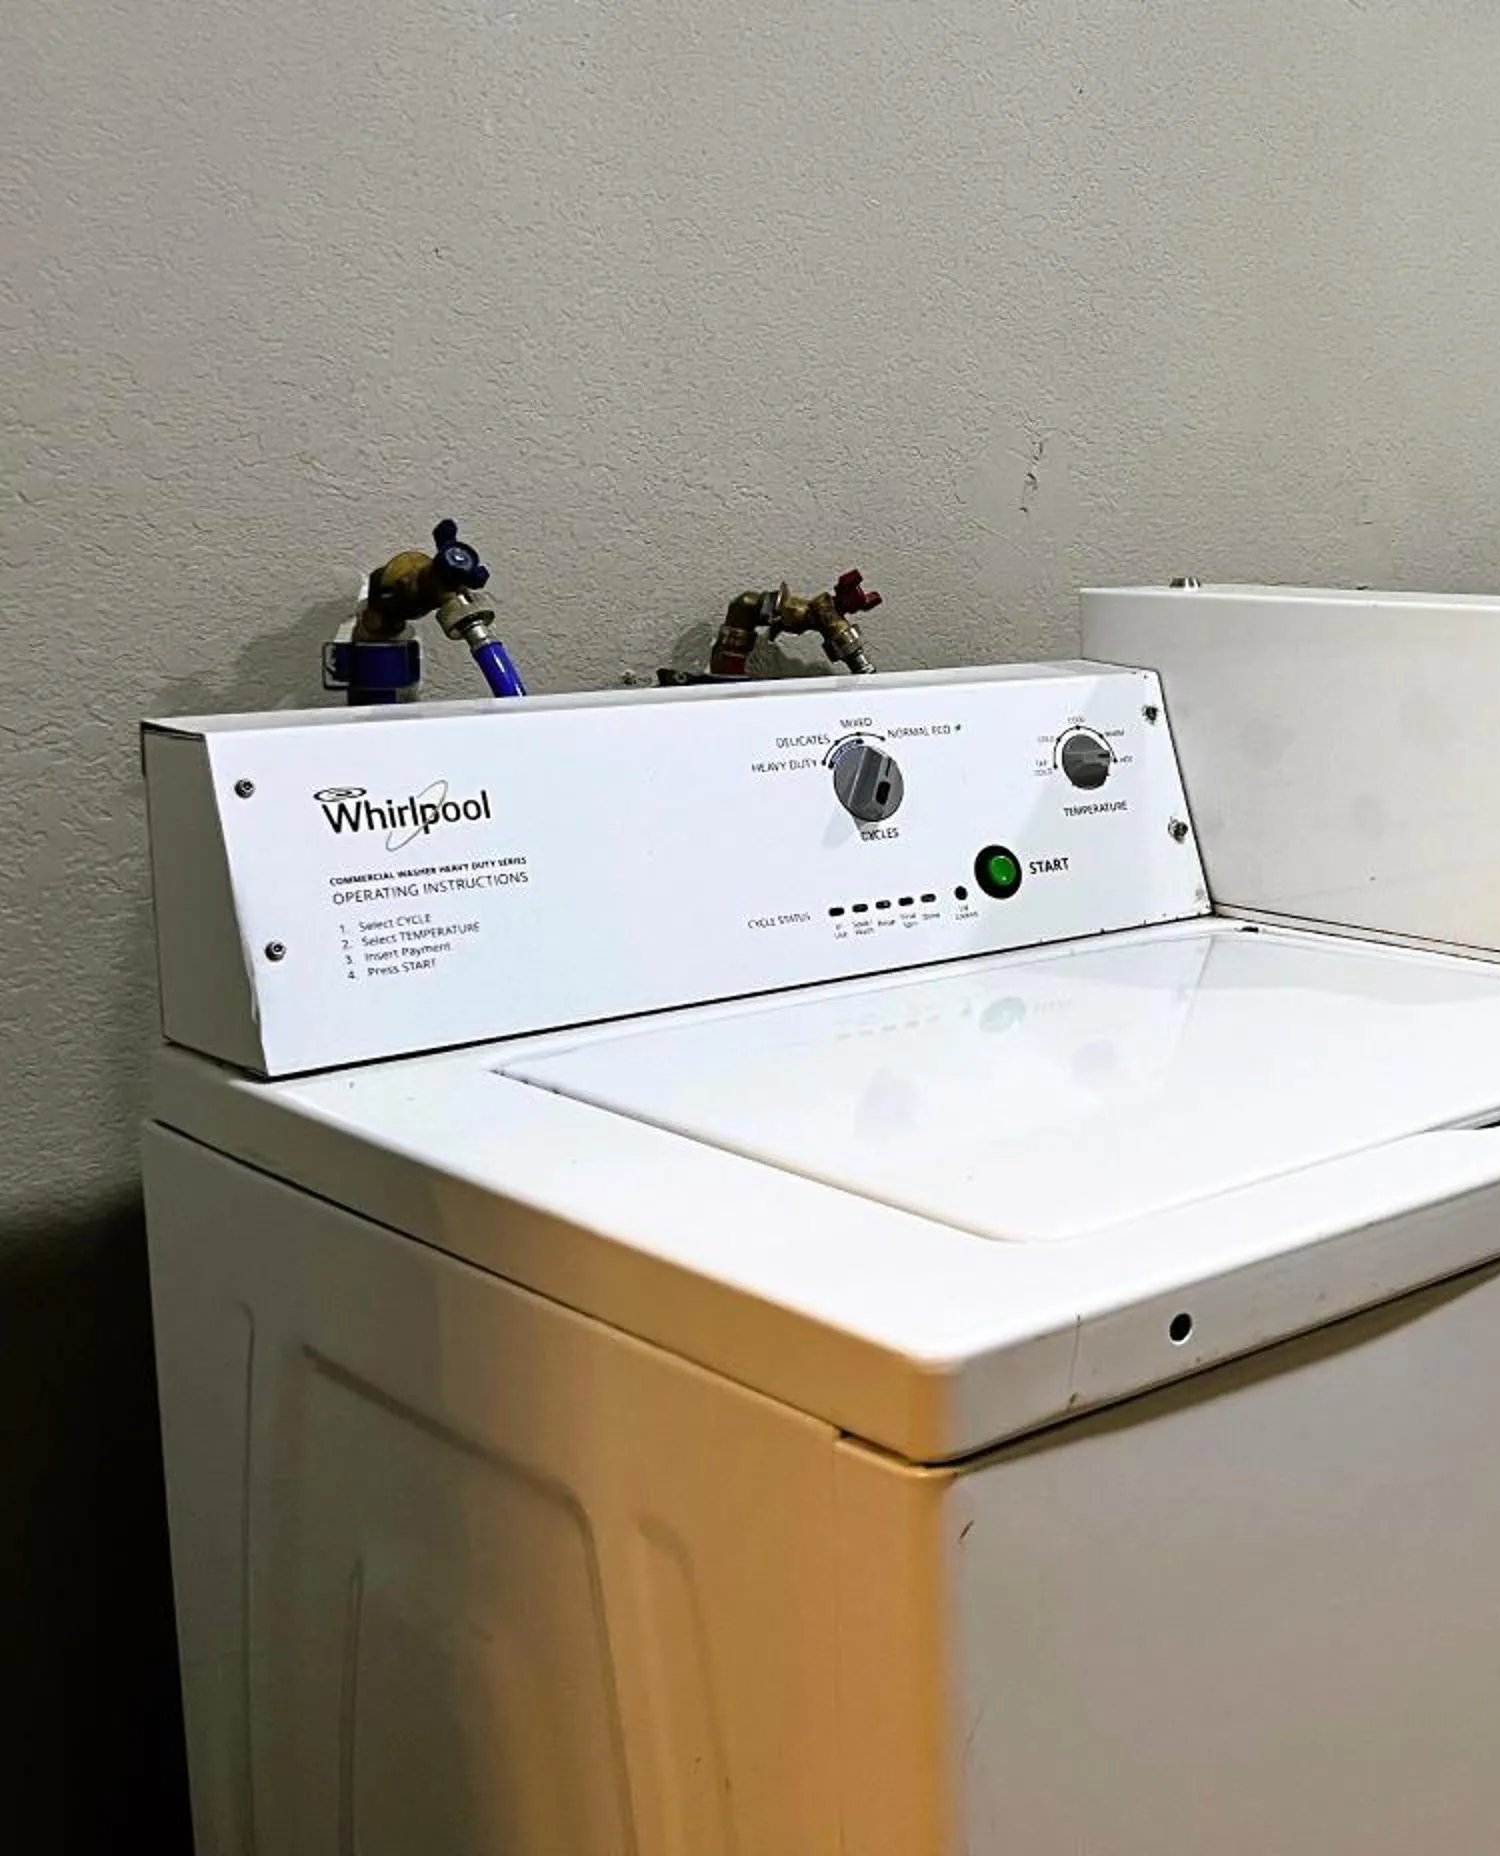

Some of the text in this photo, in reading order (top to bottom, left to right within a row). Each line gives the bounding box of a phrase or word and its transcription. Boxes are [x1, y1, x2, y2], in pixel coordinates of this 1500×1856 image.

[776, 733, 831, 749] DELICATES
[751, 758, 818, 774] HEAVY DUTY
[321, 789, 491, 835] Whirlpool
[1063, 801, 1129, 817] TEMPERATURE
[861, 827, 900, 842] CYCLES
[329, 872, 395, 887] COMMERCIAL
[397, 866, 437, 878] WASHER
[439, 863, 469, 874] HEAVY
[471, 860, 495, 870] DUTY
[1029, 857, 1069, 875] START
[332, 871, 529, 905] OPERATING INSTRUCTIONS
[358, 919, 395, 933] Select
[396, 913, 431, 927] CYCLE
[361, 934, 398, 947] Select
[398, 921, 481, 941] TEMPERATURE
[364, 949, 399, 962] Insert
[401, 942, 451, 957] Payment
[367, 965, 400, 977] Press
[401, 958, 437, 973] START
